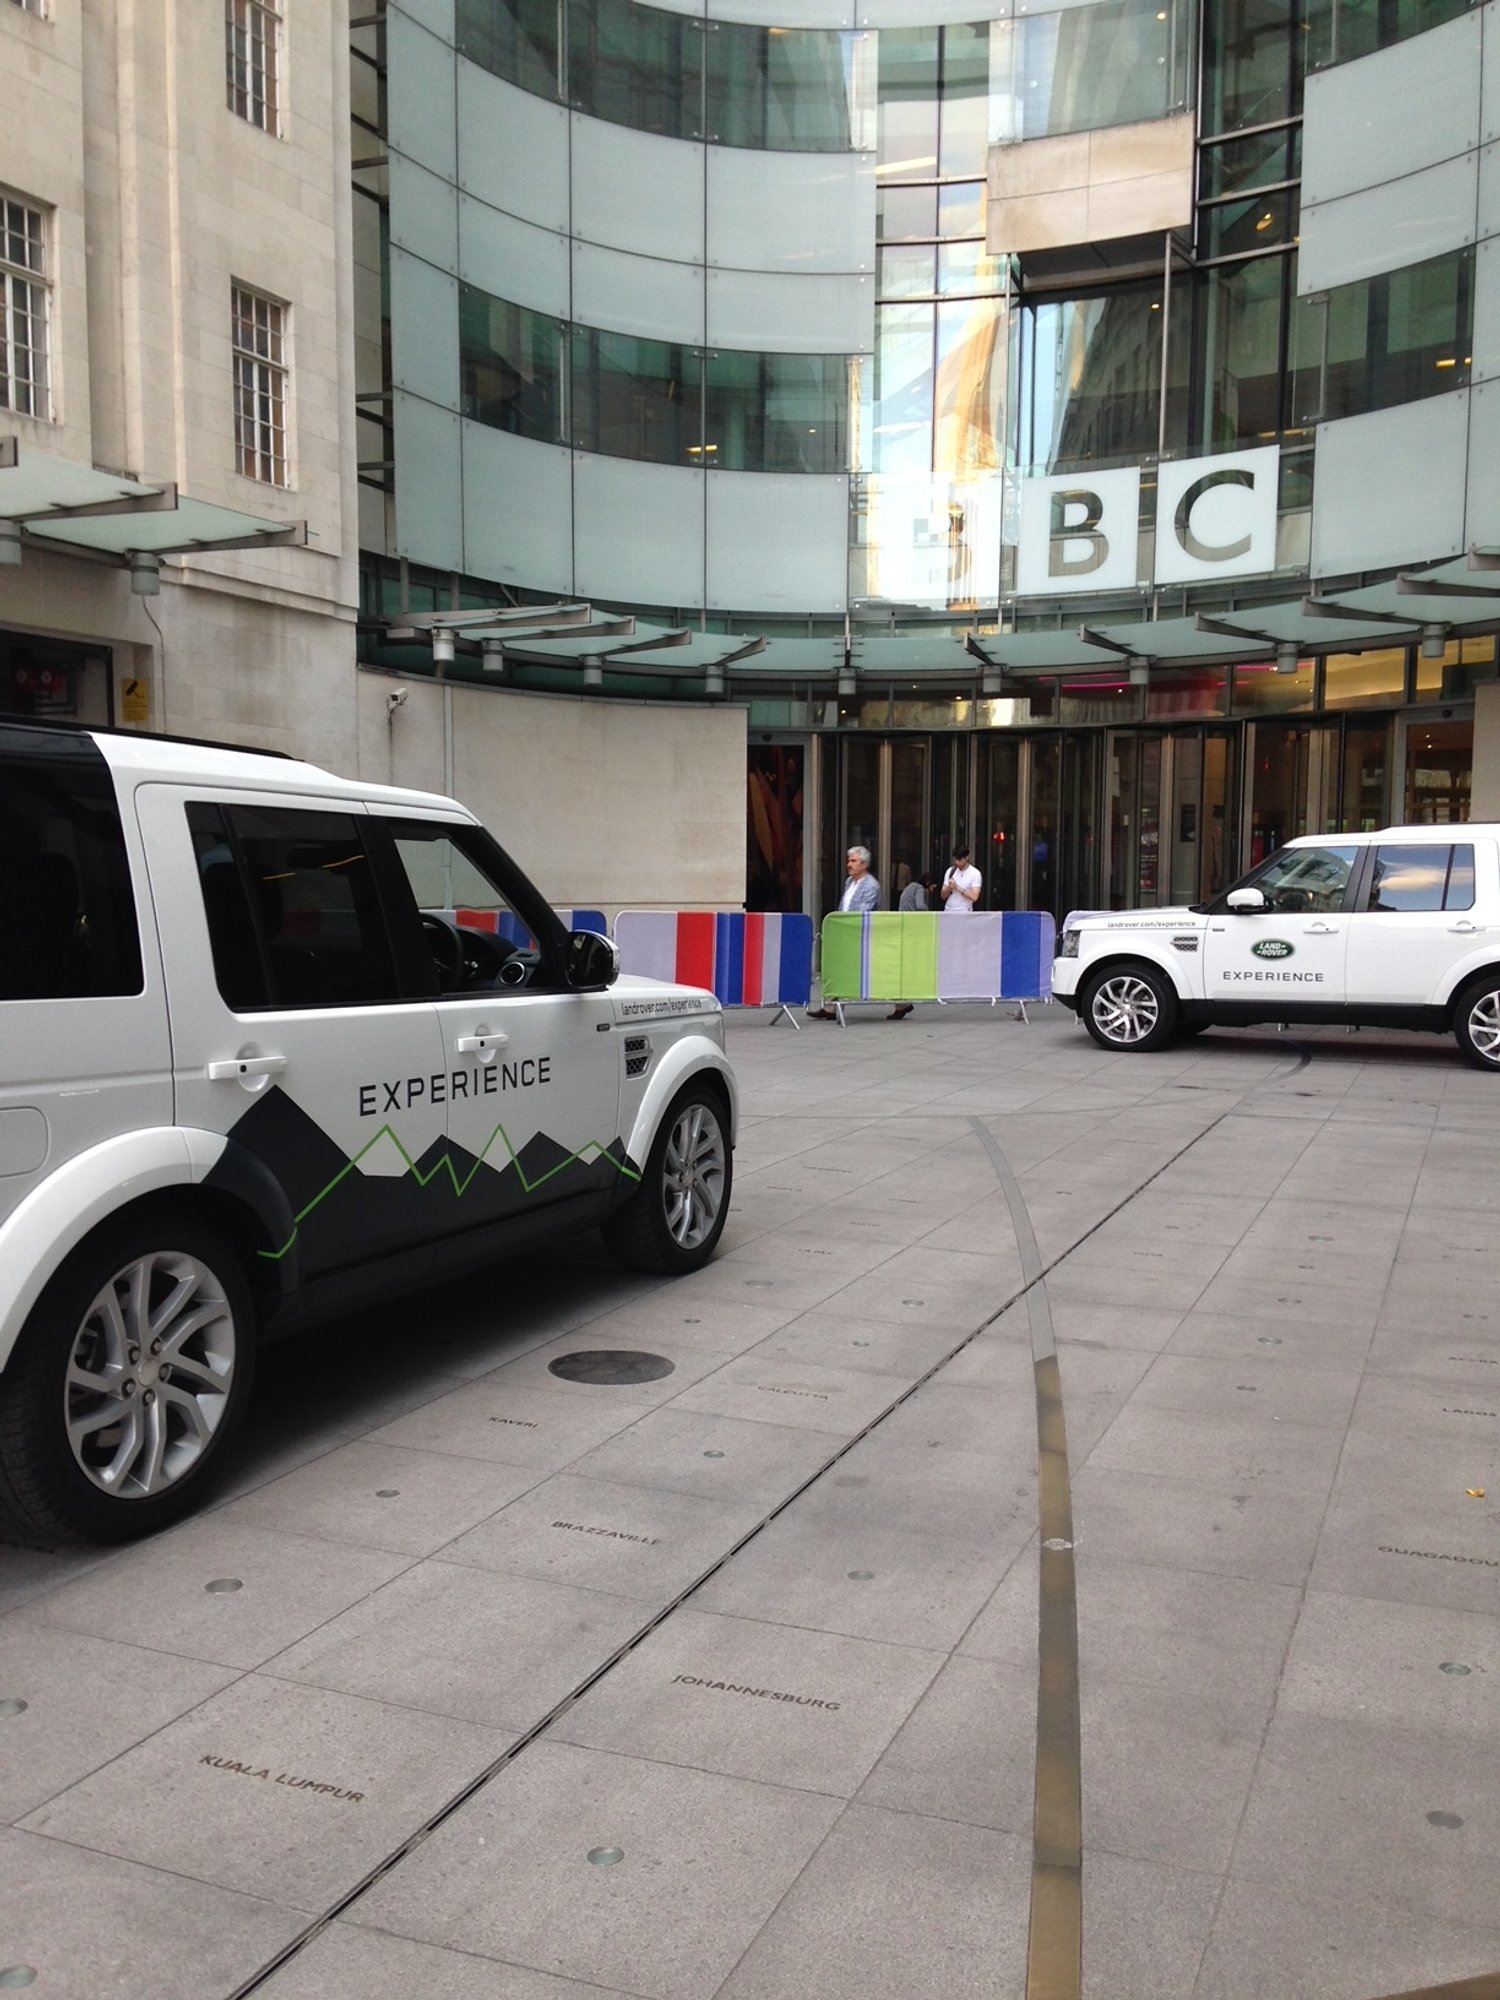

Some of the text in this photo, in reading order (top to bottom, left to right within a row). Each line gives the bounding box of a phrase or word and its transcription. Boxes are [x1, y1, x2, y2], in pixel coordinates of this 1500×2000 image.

[1223, 971, 1324, 982] EXPERIENCE
[359, 1057, 551, 1117] EXPERIENCE
[671, 1674, 842, 1711] JOHANNESBURG
[199, 1754, 365, 1803] KUALA LUMPUR
